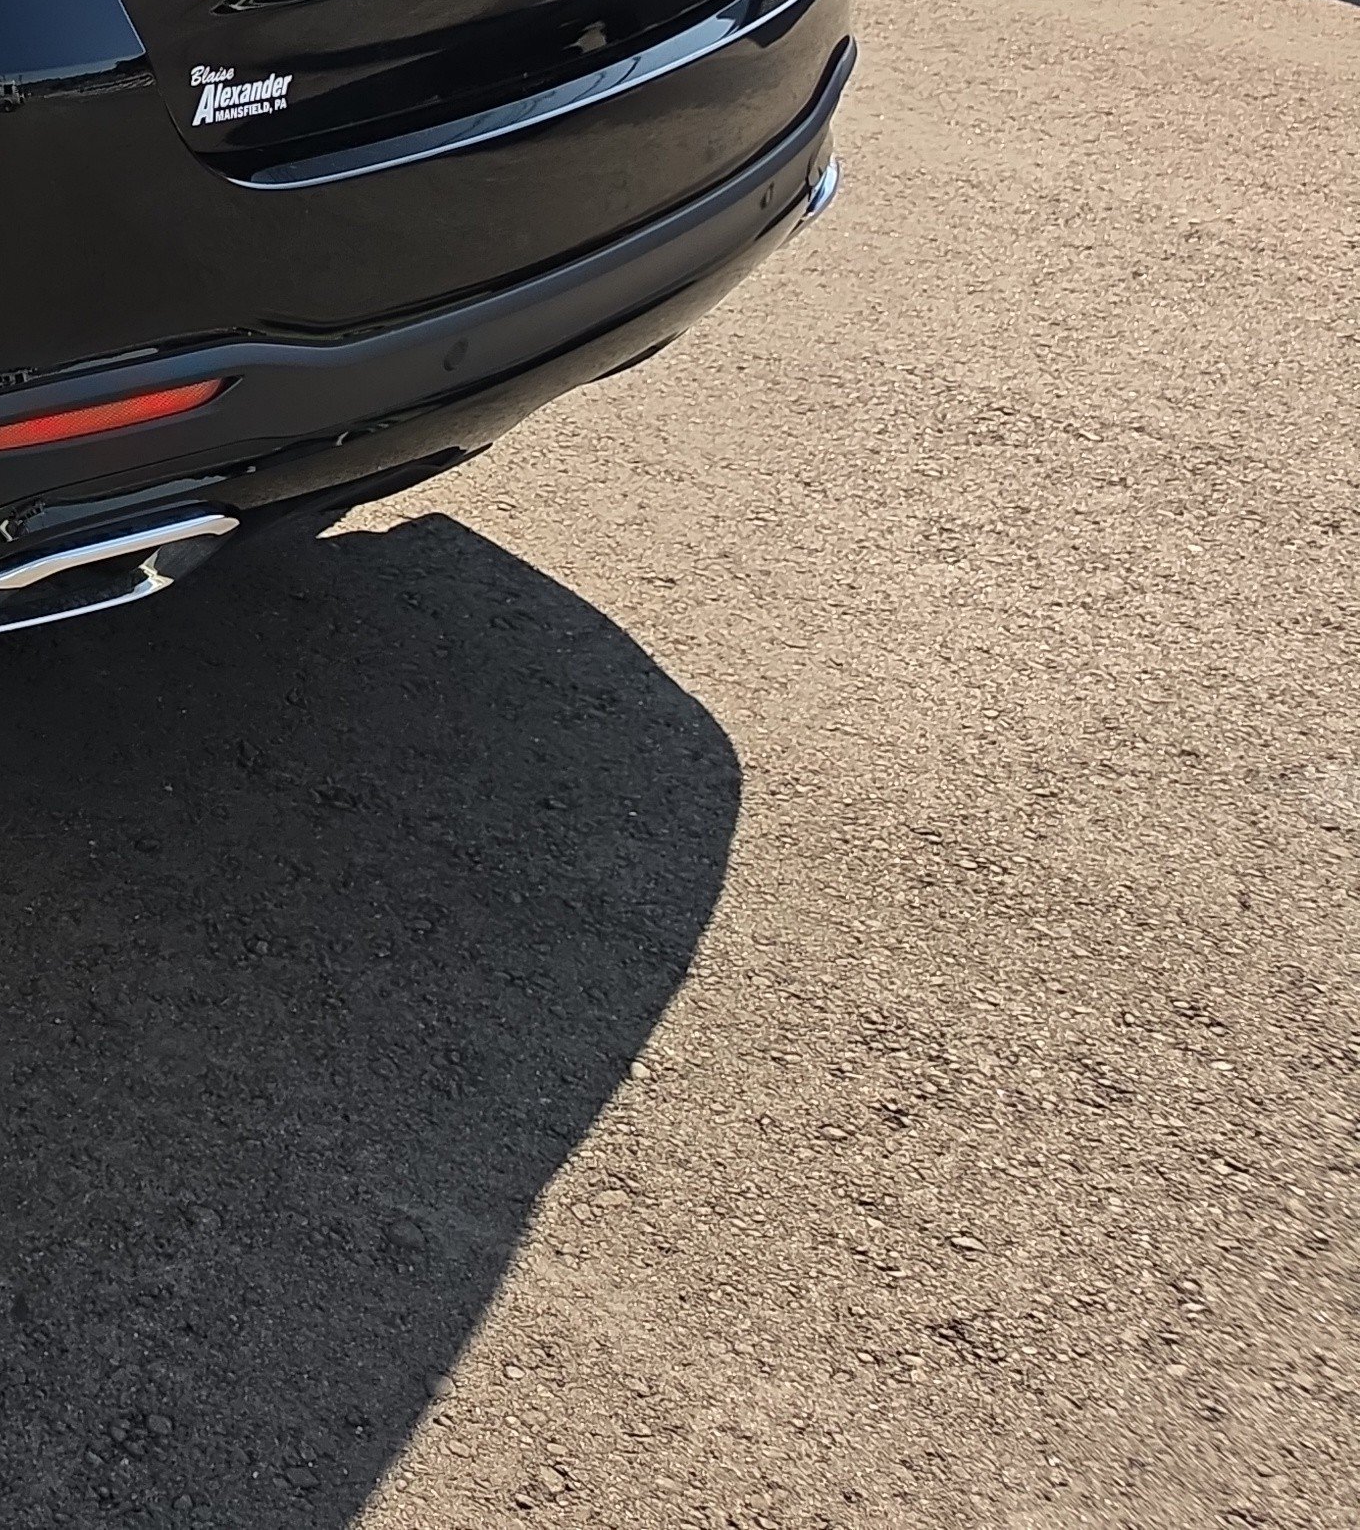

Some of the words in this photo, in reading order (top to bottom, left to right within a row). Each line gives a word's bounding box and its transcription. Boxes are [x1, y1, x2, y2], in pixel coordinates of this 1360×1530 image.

[190, 65, 235, 87] Blaise
[191, 72, 293, 127] Alexander
[214, 101, 274, 123] MANSFIELD,
[274, 97, 288, 111] PA
